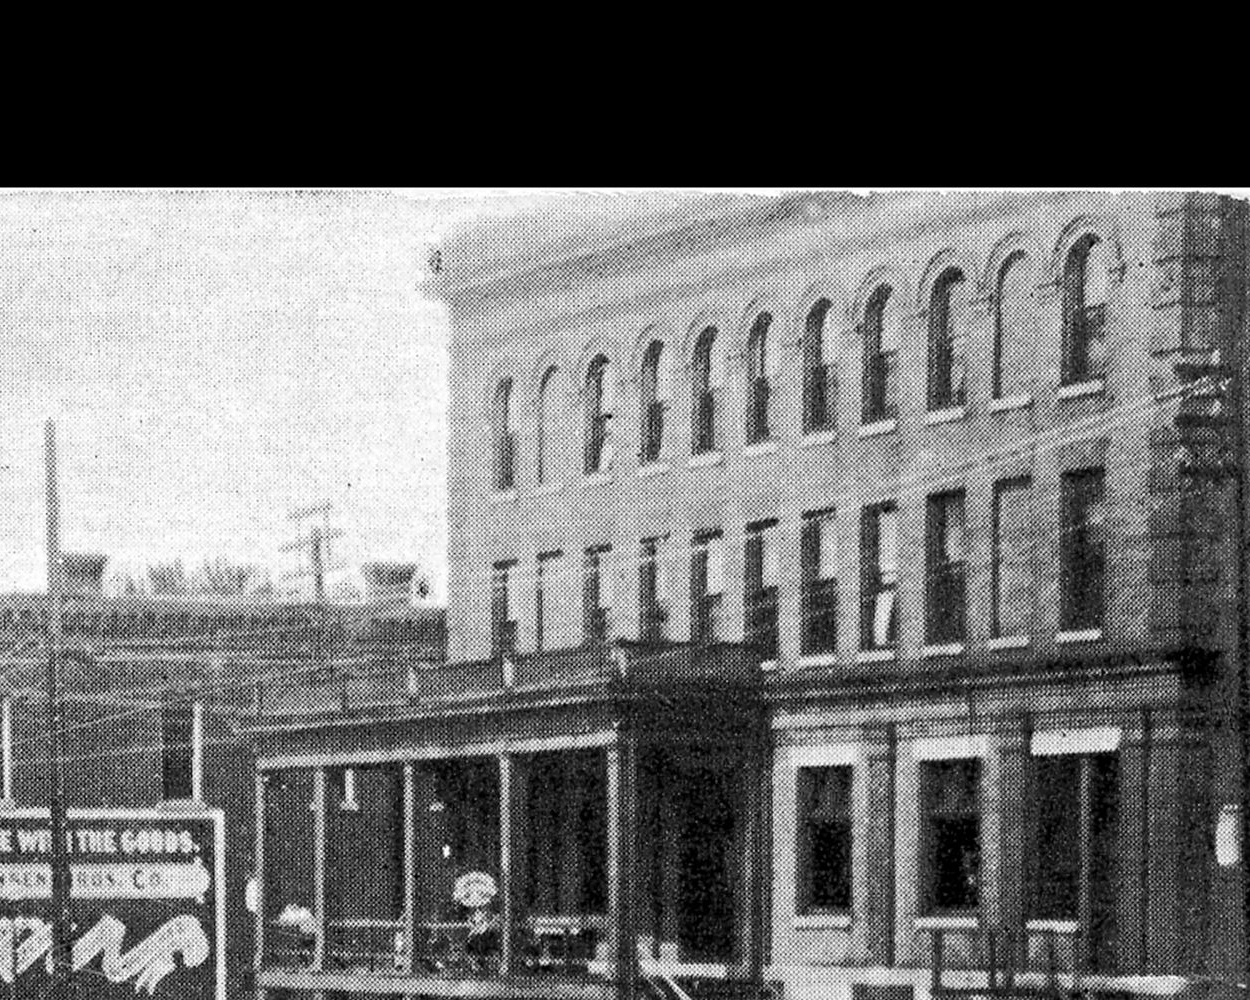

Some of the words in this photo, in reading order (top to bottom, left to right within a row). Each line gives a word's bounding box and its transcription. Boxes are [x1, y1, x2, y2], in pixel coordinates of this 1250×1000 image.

[76, 829, 117, 852] THE
[120, 829, 200, 852] GOODS.
[66, 871, 123, 887] ROS.
